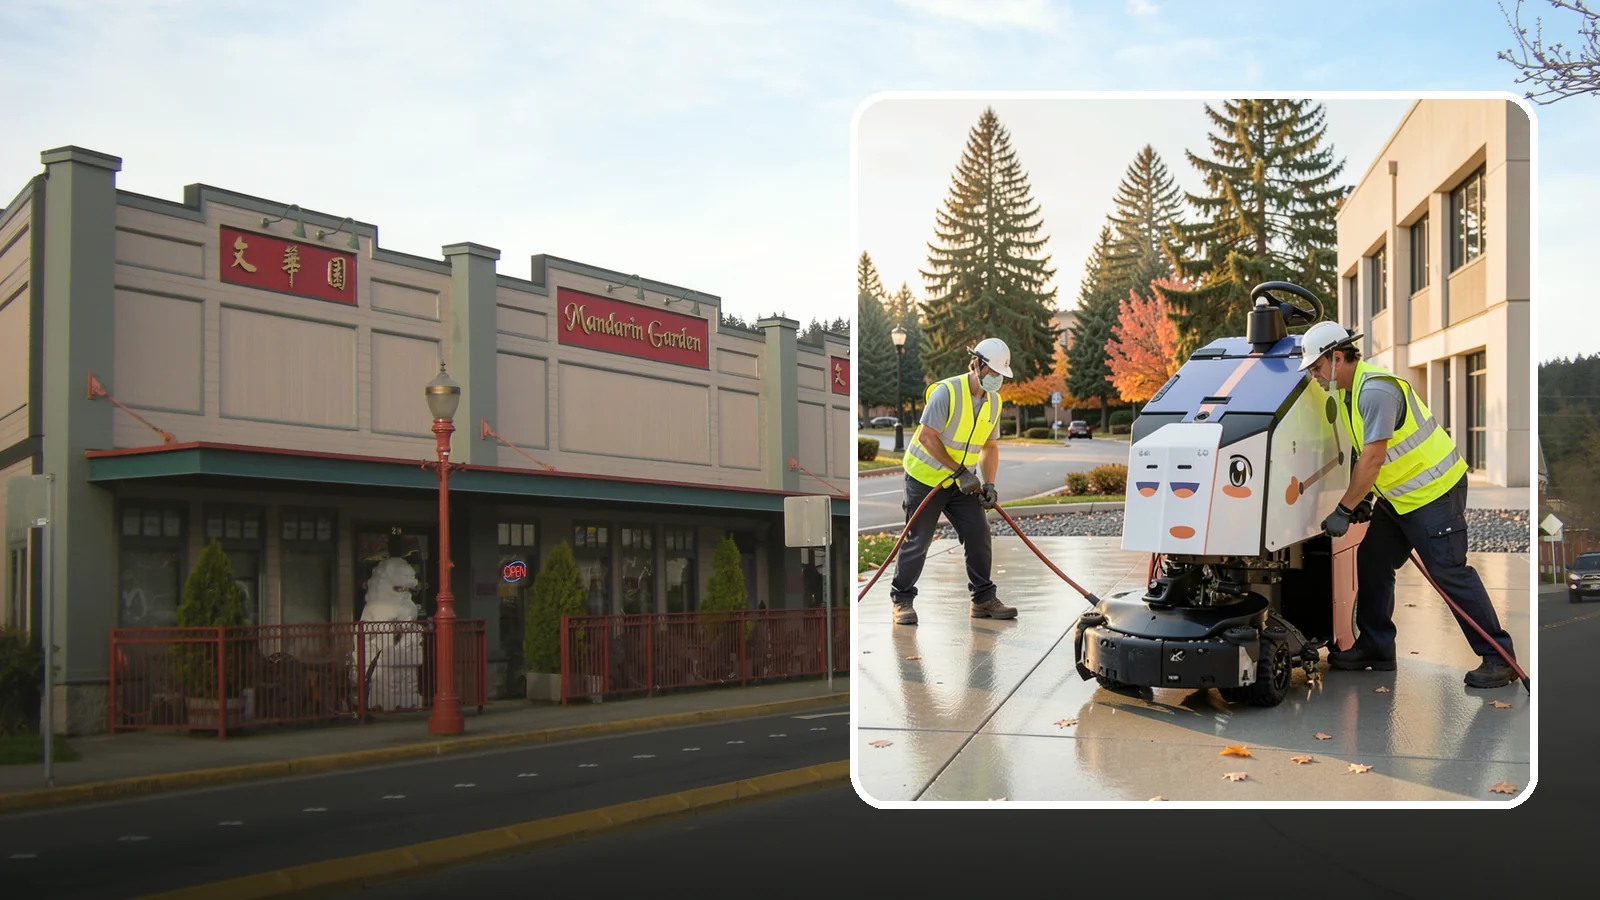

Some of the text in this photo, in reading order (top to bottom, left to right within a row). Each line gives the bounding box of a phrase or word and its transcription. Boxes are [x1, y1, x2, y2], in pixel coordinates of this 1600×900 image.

[231, 236, 346, 290] 文華園
[564, 302, 701, 352] Mandarin Garden
[503, 565, 527, 578] OPEN
